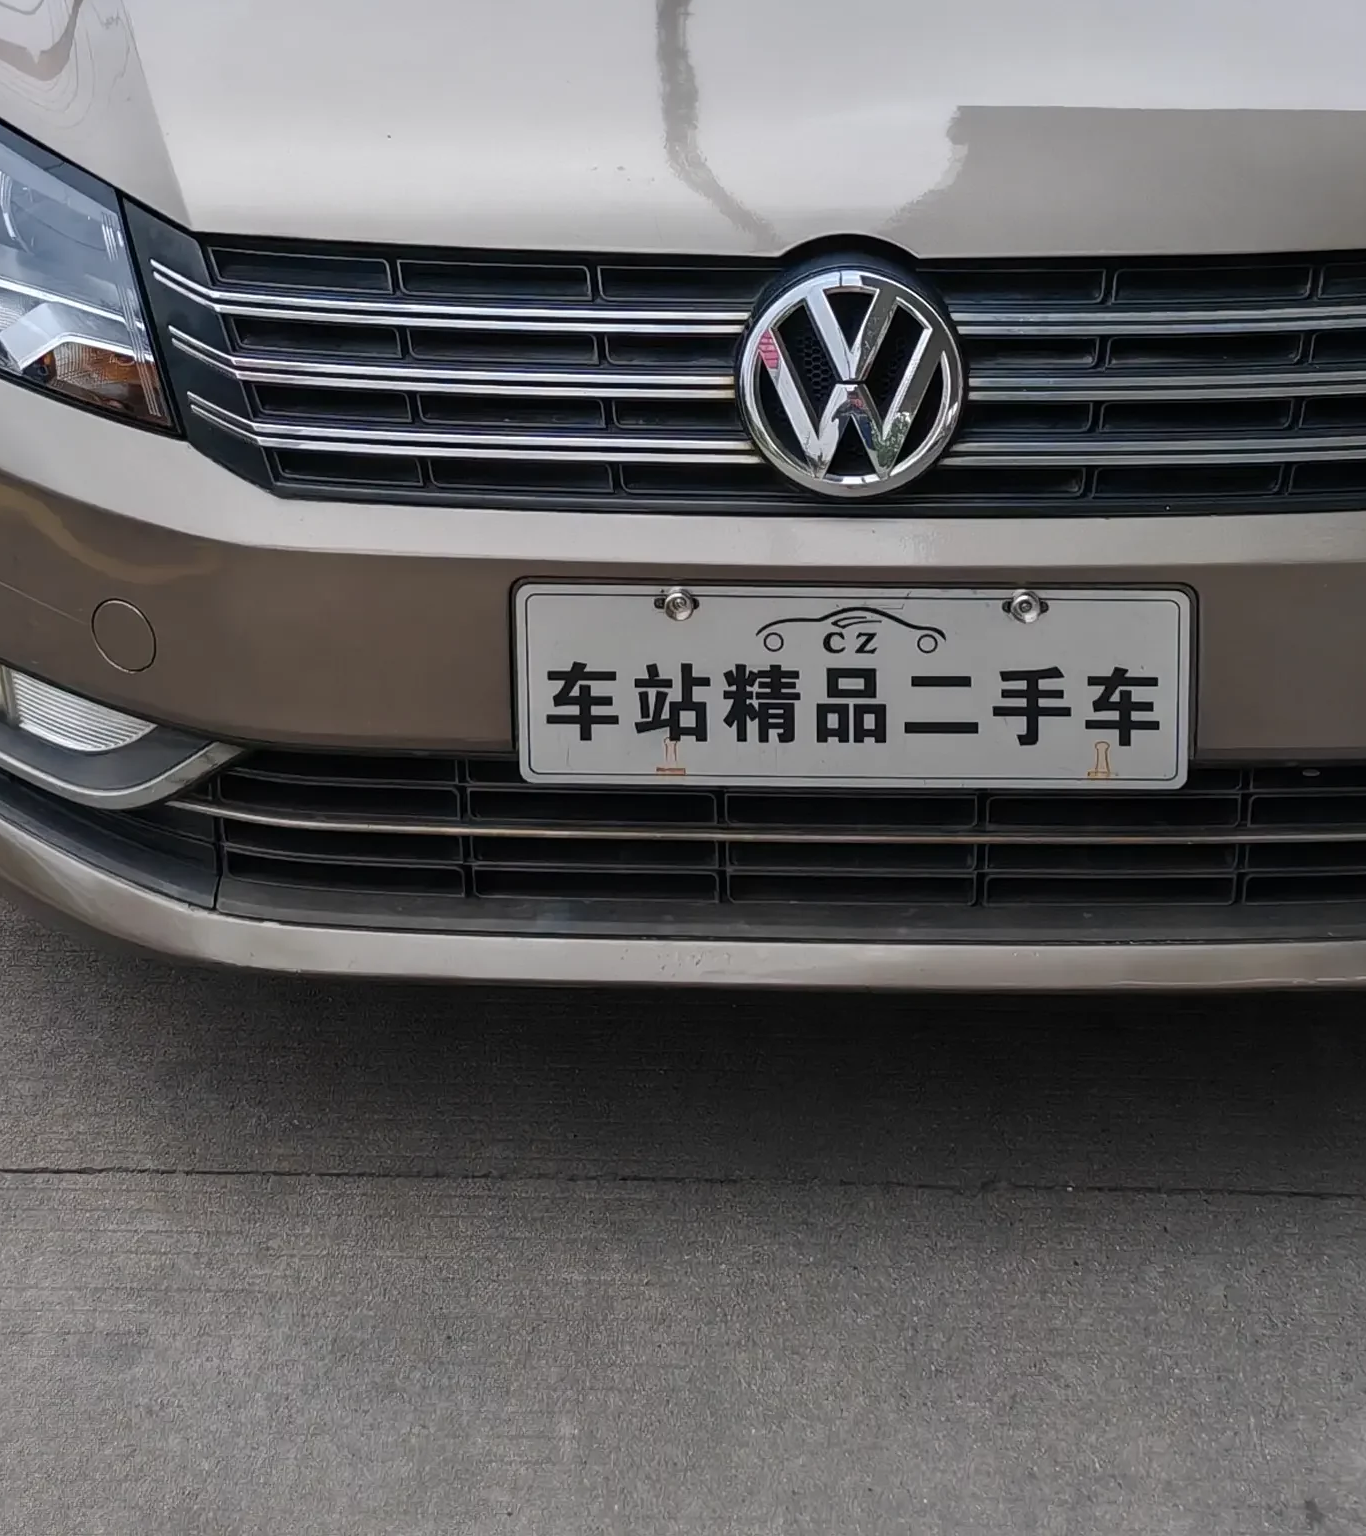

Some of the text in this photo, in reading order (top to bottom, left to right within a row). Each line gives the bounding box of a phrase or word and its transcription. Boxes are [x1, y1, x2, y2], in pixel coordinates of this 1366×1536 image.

[545, 662, 1161, 747] 车站精品二手车
